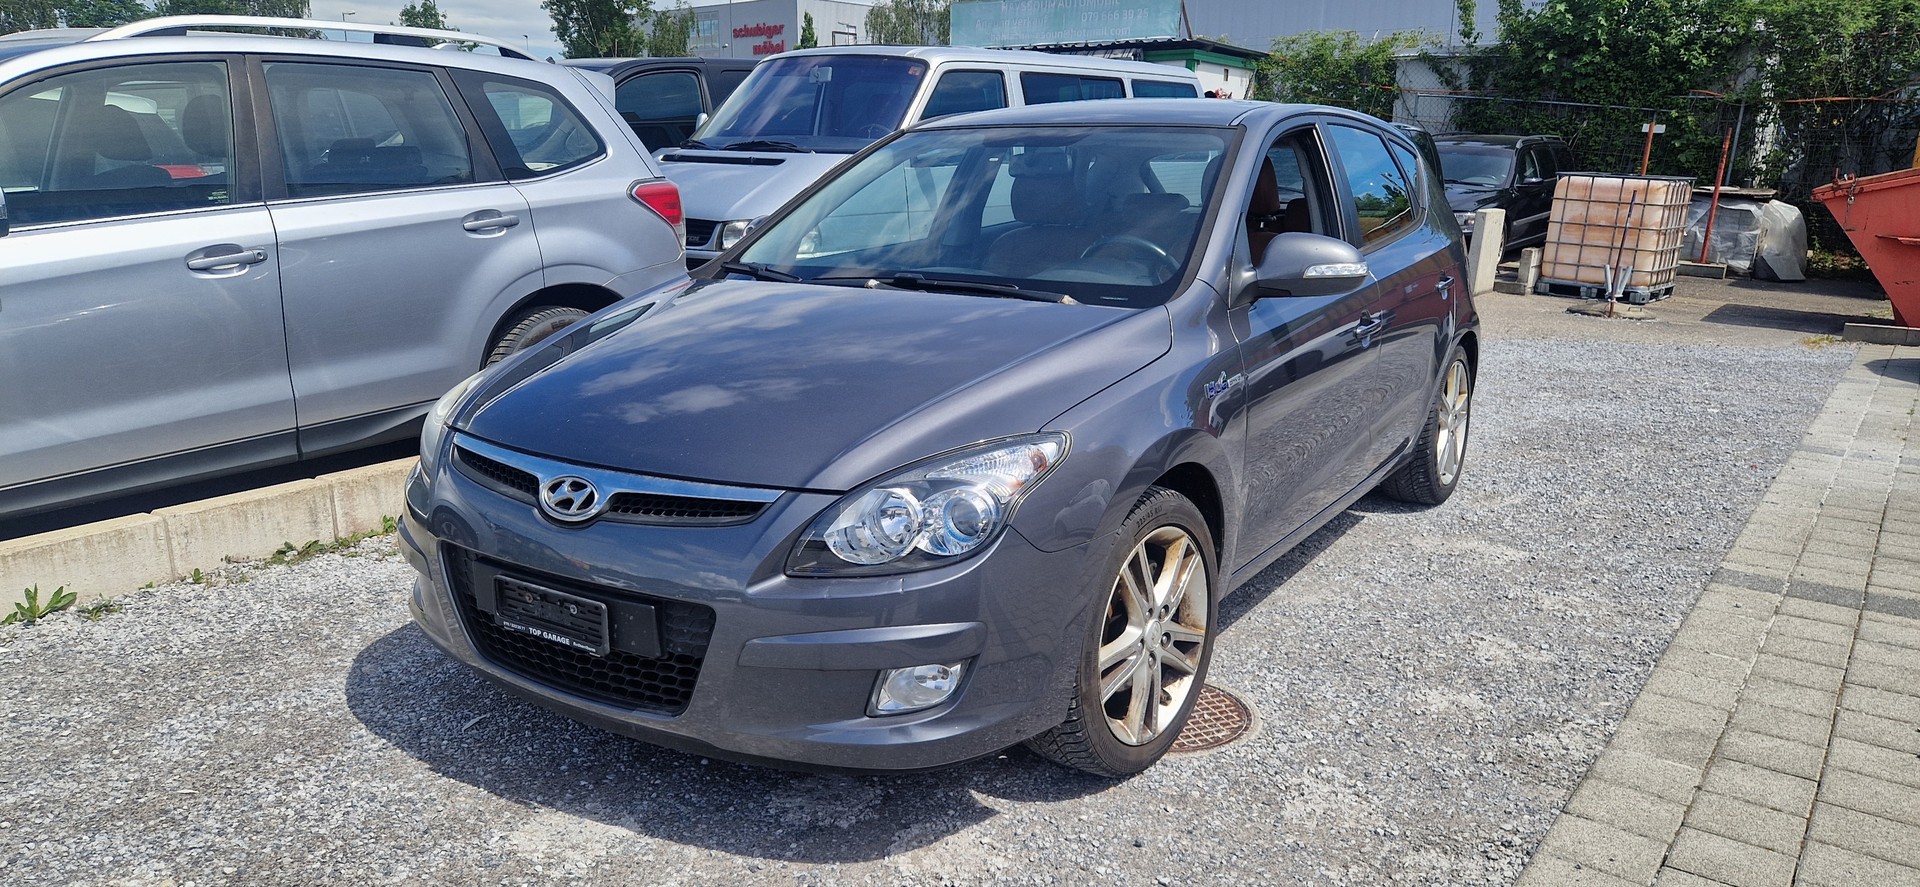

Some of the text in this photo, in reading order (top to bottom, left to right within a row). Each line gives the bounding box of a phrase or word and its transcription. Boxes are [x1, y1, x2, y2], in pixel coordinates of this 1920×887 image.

[733, 23, 785, 38] schubiger
[752, 40, 785, 55] möbel
[528, 627, 570, 645] TOP GARAGE
